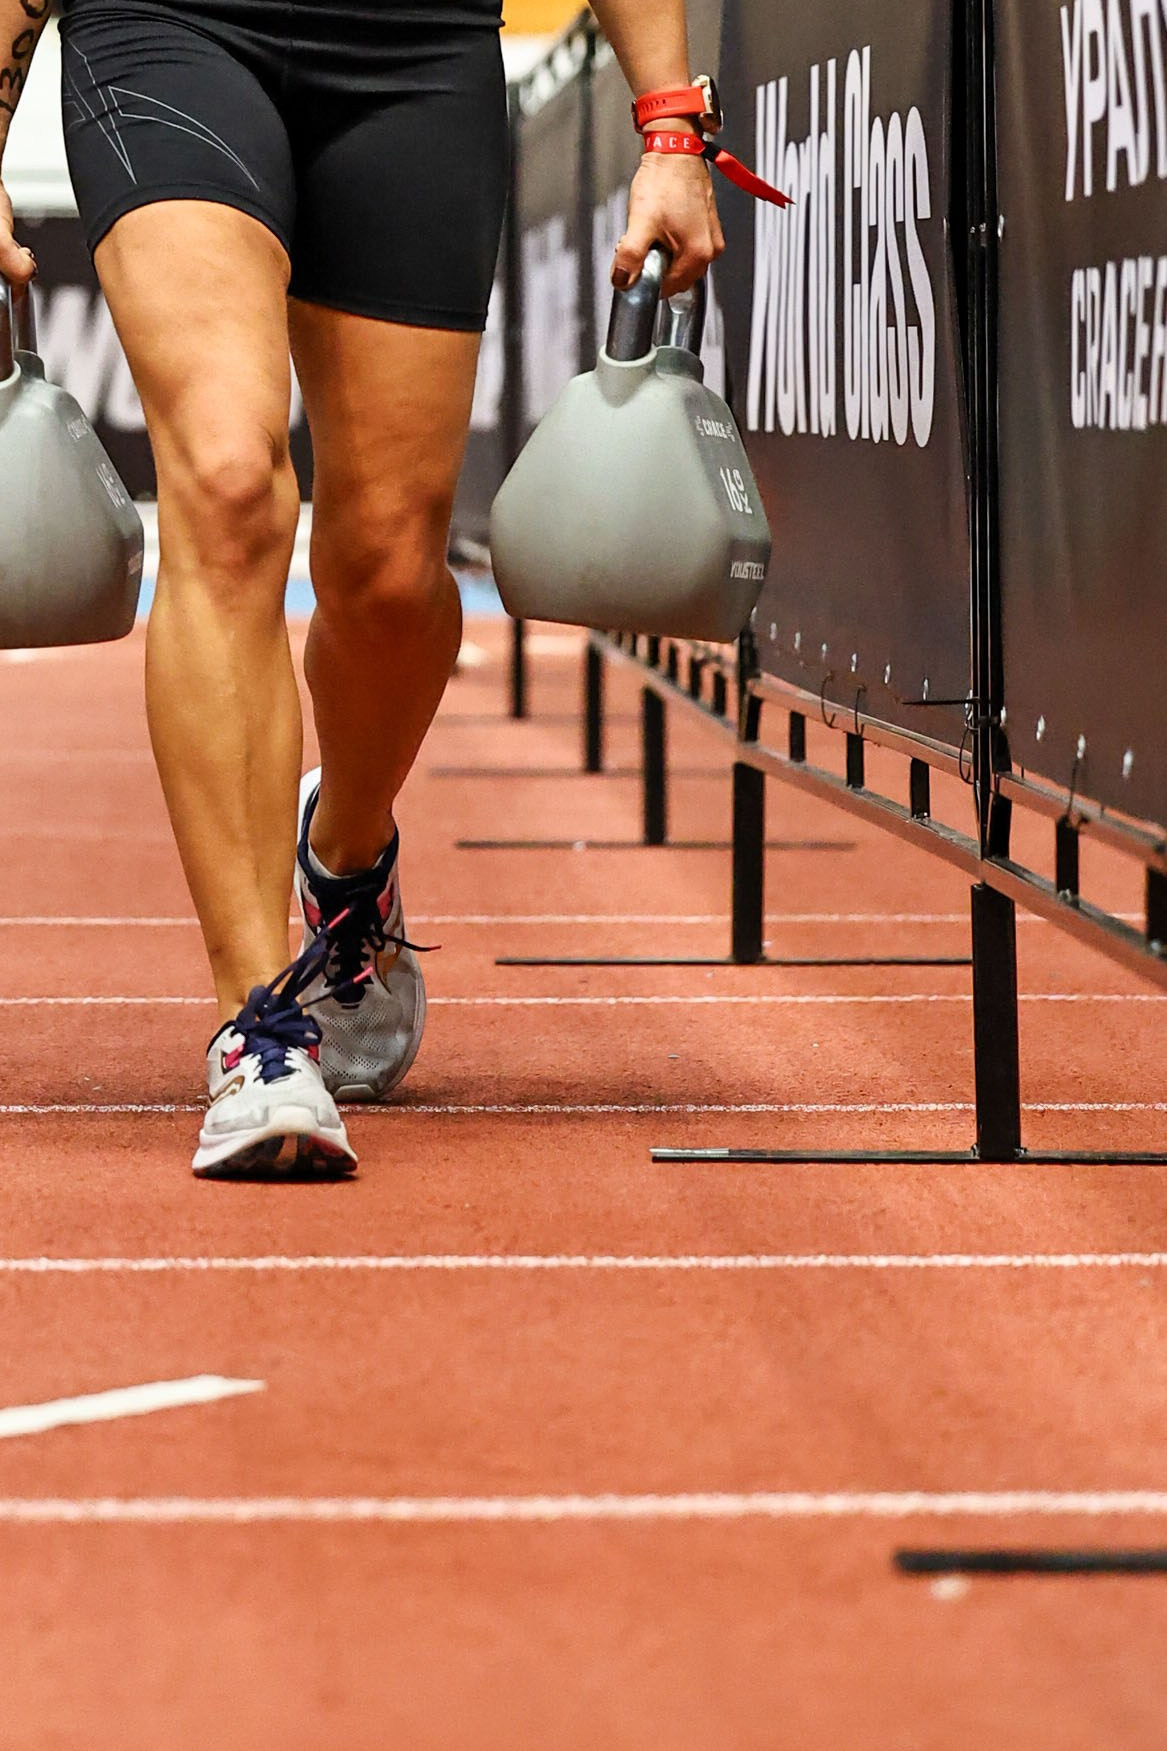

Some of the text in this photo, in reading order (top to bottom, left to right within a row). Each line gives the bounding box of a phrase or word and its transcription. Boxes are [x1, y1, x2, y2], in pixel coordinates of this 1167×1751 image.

[746, 57, 837, 438] World
[844, 45, 936, 448] Class
[719, 466, 743, 512] 16
